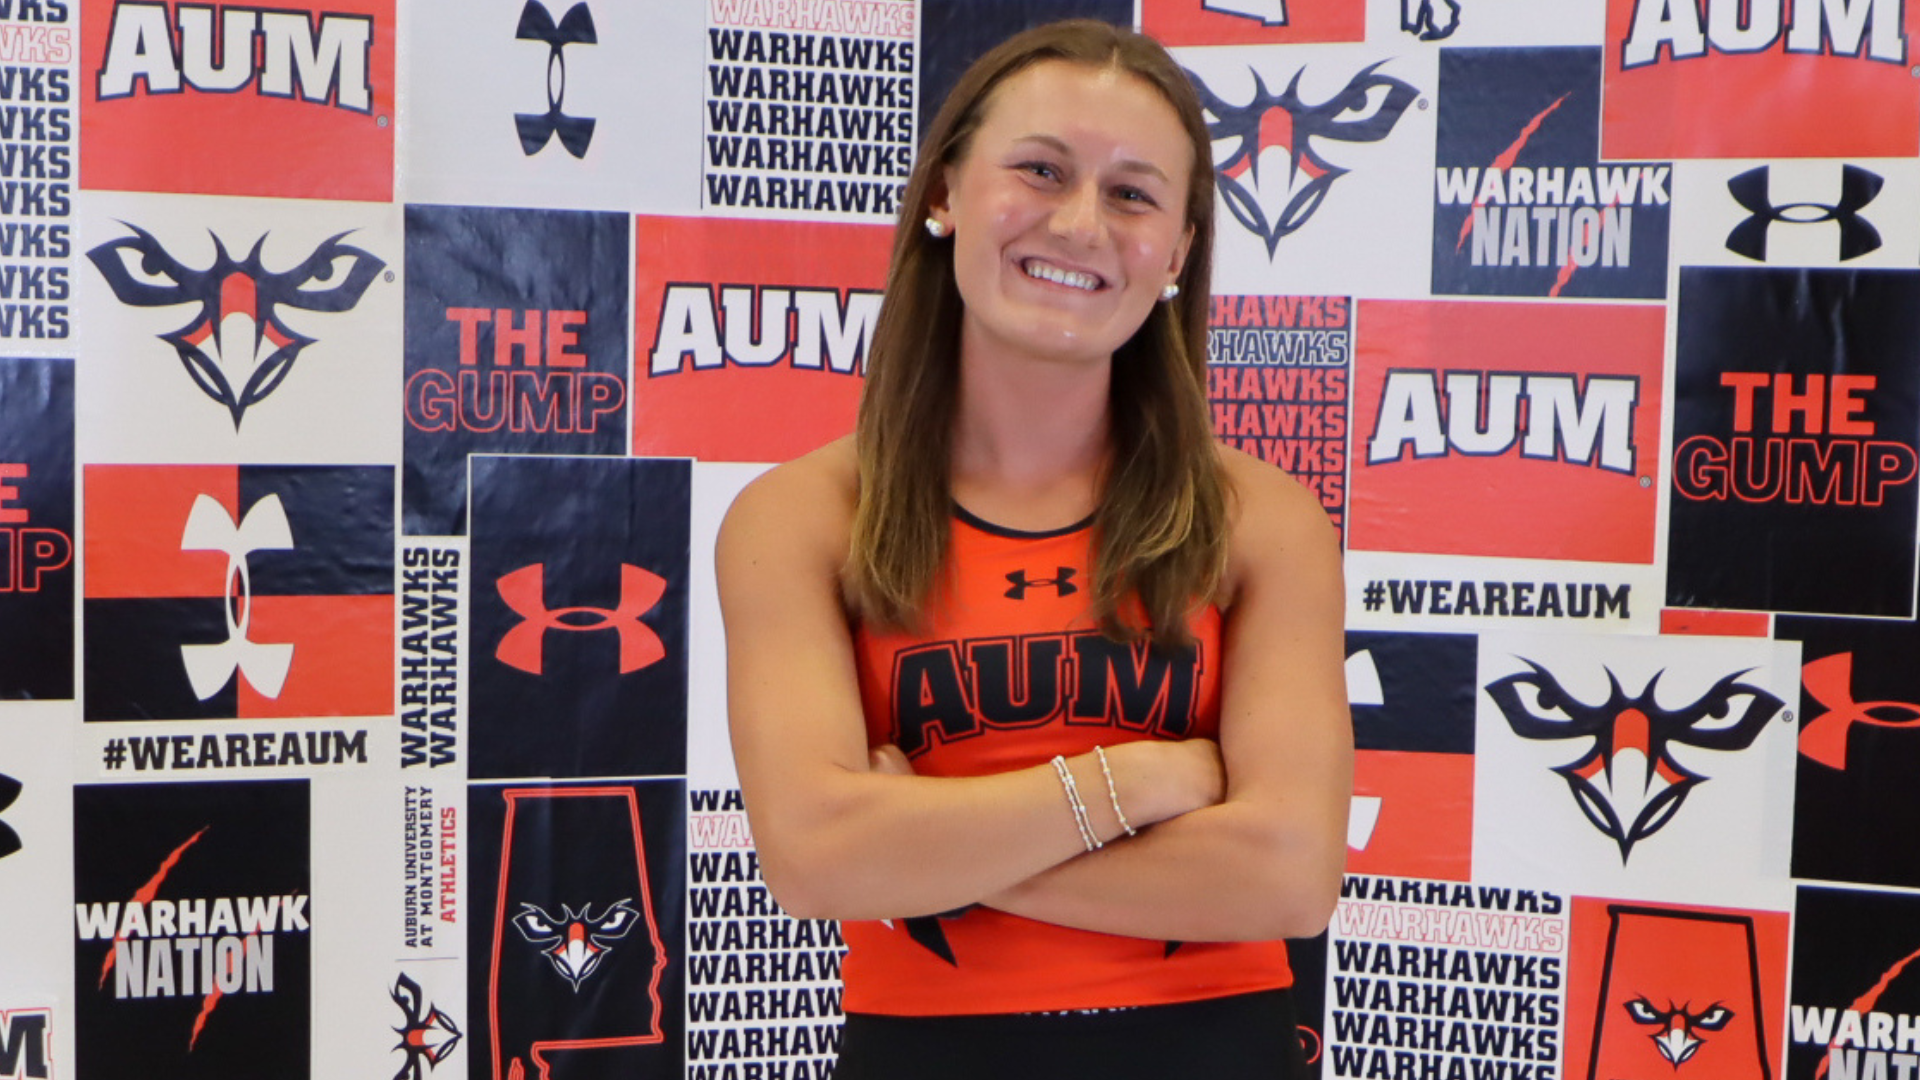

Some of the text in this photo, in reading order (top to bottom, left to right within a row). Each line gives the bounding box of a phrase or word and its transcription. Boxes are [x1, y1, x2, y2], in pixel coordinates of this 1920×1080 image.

[711, 0, 914, 38] WARHAWKS
[1621, 0, 1908, 71] AUM
[96, 1, 374, 116] AUM
[709, 28, 914, 73] WARHAWKS
[709, 64, 913, 109] WARHAWKS
[707, 100, 913, 143] WARHAWKS
[707, 135, 911, 177] WARHAWKS
[1436, 166, 1671, 205] WARHAWK
[1471, 206, 1632, 267] NATION
[446, 307, 587, 367] THE
[648, 281, 886, 377] AUM
[1207, 296, 1346, 327] HAWKS
[404, 368, 626, 433] GUMP
[1206, 367, 1346, 401] HAWKS
[1721, 372, 1877, 435] THE
[1366, 367, 1640, 477] AUM
[1672, 435, 1918, 506] GUMP
[1363, 579, 1632, 619] #WEAREAUM
[401, 547, 430, 768] WARHAWKS
[430, 549, 460, 768] WARHAWKS
[891, 629, 1203, 760] AUM
[103, 730, 368, 771] #WEAREAUM
[405, 786, 418, 948] AUBURN UNIVERSITY
[420, 786, 433, 948] AT MONTGOMERY
[440, 807, 456, 923] ATHLETICS
[75, 894, 310, 940] WARHAWK
[1337, 901, 1563, 953] WARHAWKS
[115, 934, 274, 999] NATION
[1334, 939, 1560, 990] WARHAWKS
[1333, 975, 1559, 1027] WARHAWKS
[1332, 1010, 1557, 1061] WARHAWKS
